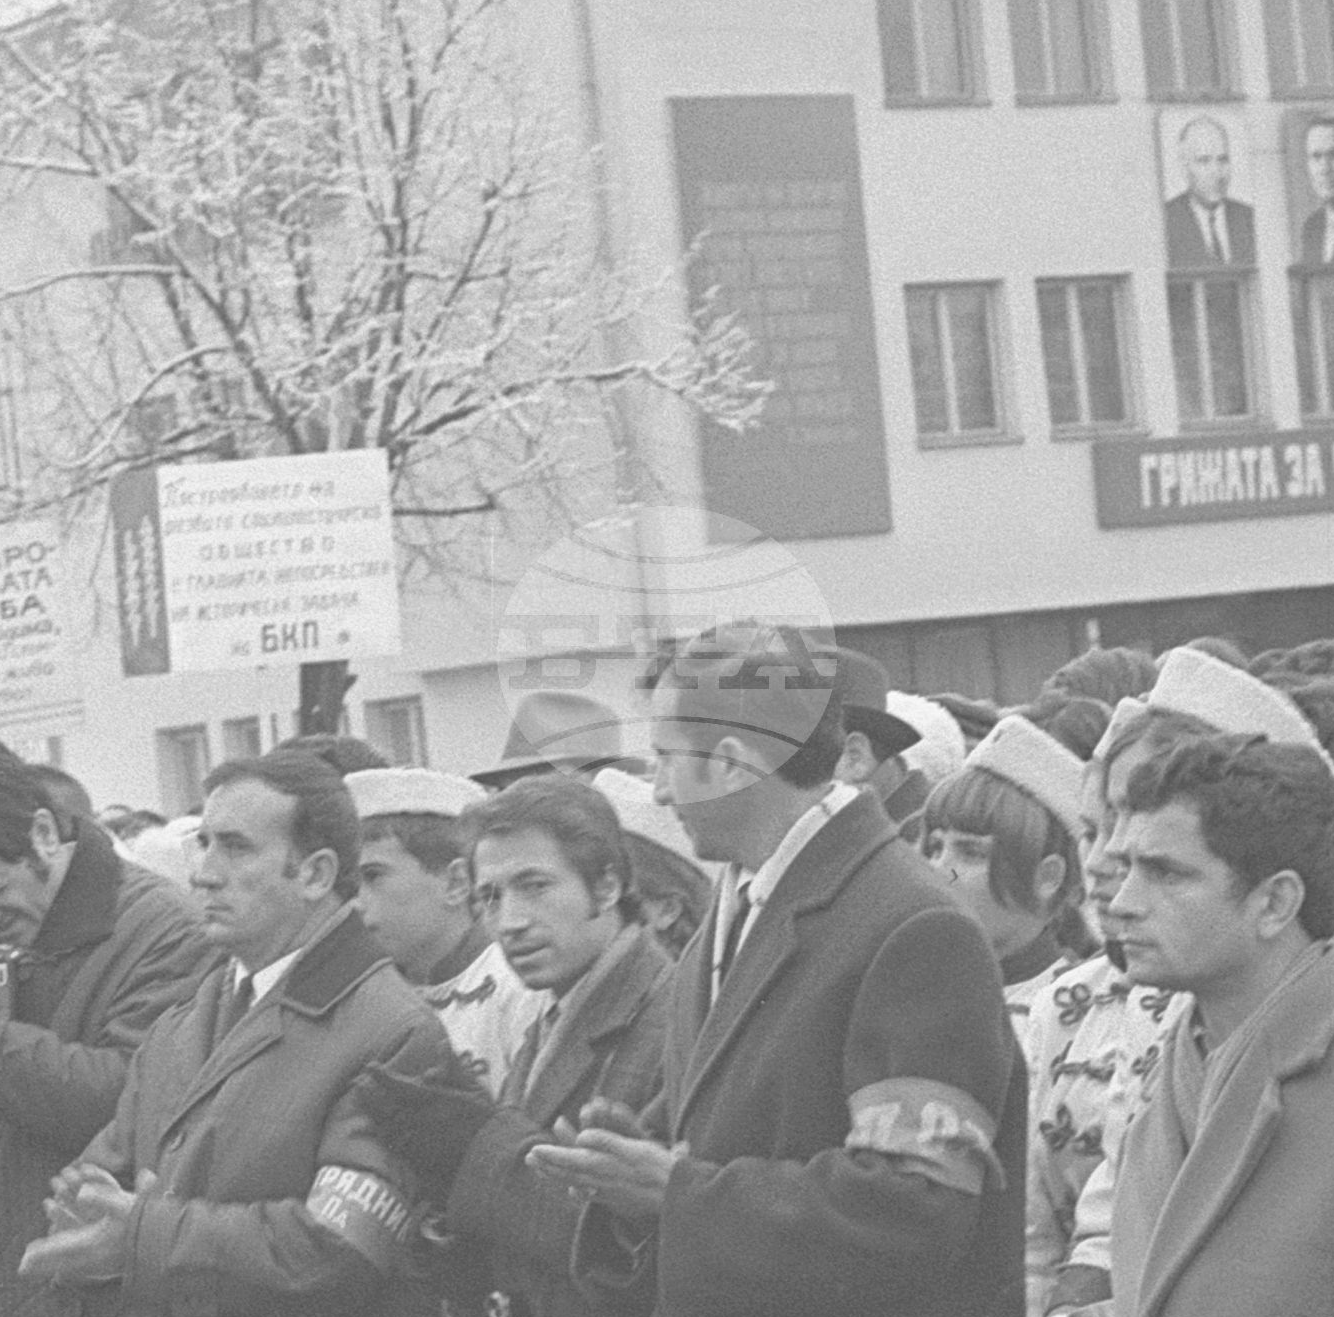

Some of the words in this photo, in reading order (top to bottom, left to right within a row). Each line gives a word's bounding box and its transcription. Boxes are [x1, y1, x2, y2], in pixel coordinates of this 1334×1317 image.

[1139, 446, 1280, 508] ГРИЖАТА
[1284, 442, 1326, 497] ЗА
[261, 620, 319, 653] БКП
